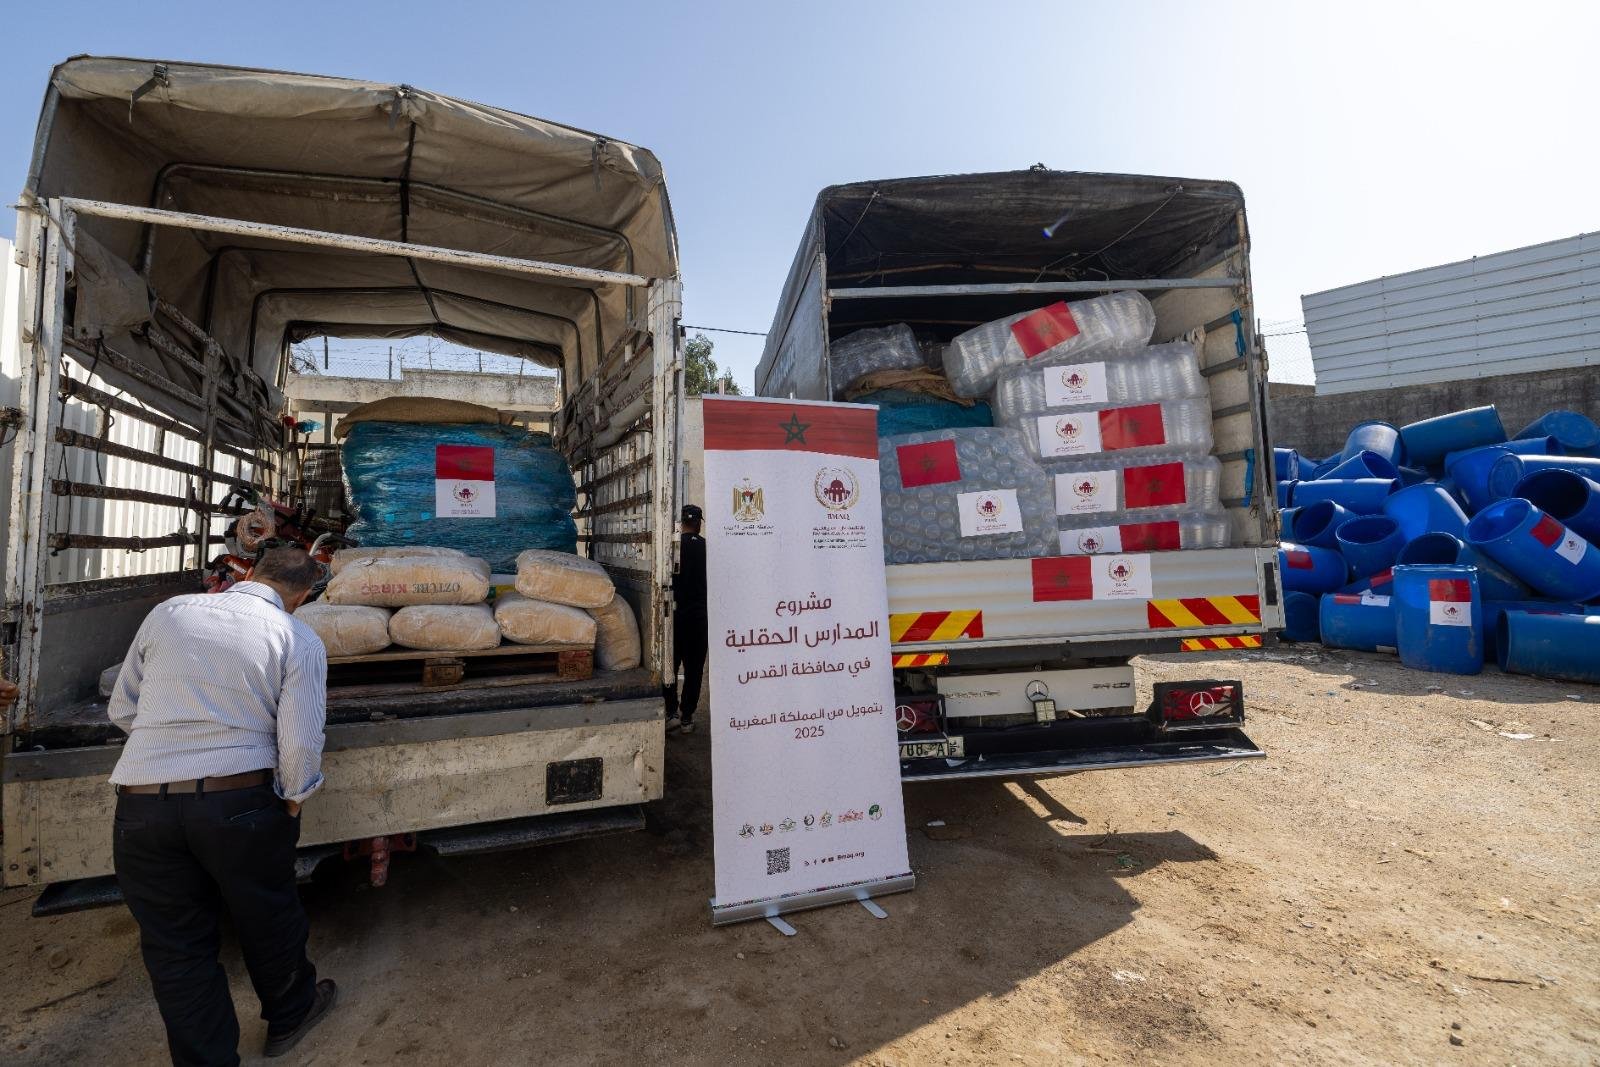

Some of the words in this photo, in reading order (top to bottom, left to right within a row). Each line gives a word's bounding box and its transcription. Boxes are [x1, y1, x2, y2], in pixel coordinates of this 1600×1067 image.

[775, 591, 832, 617] مشروع
[725, 626, 798, 653] الحقلية
[804, 620, 879, 648] المدارس
[738, 664, 788, 685] القدس
[791, 660, 845, 675] محافظة
[848, 656, 871, 678] في
[779, 708, 825, 723] المملكة
[827, 707, 844, 720] من
[846, 702, 883, 718] بتمويل
[729, 713, 777, 731] المغربية
[794, 725, 825, 740] 2025
